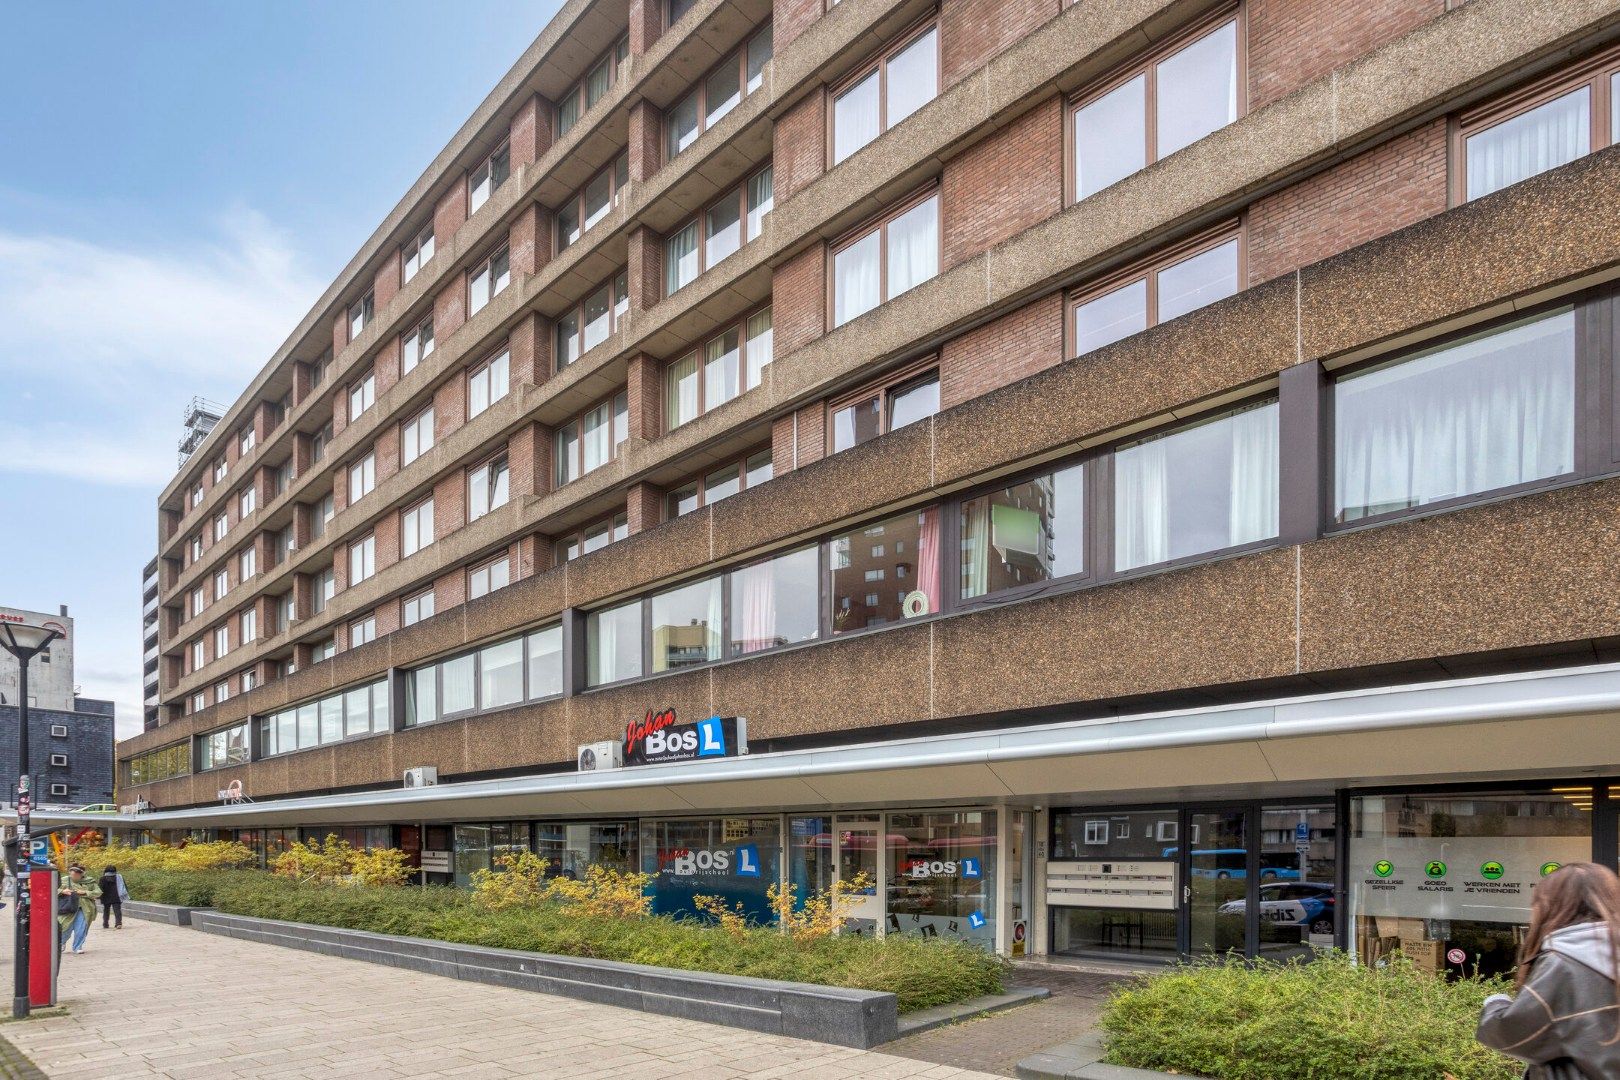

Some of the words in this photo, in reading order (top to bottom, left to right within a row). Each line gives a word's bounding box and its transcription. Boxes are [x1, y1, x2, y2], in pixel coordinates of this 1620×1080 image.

[627, 709, 675, 754] Johan
[703, 723, 720, 750] L
[30, 841, 45, 854] P
[740, 849, 756, 872] L
[966, 861, 977, 875] L
